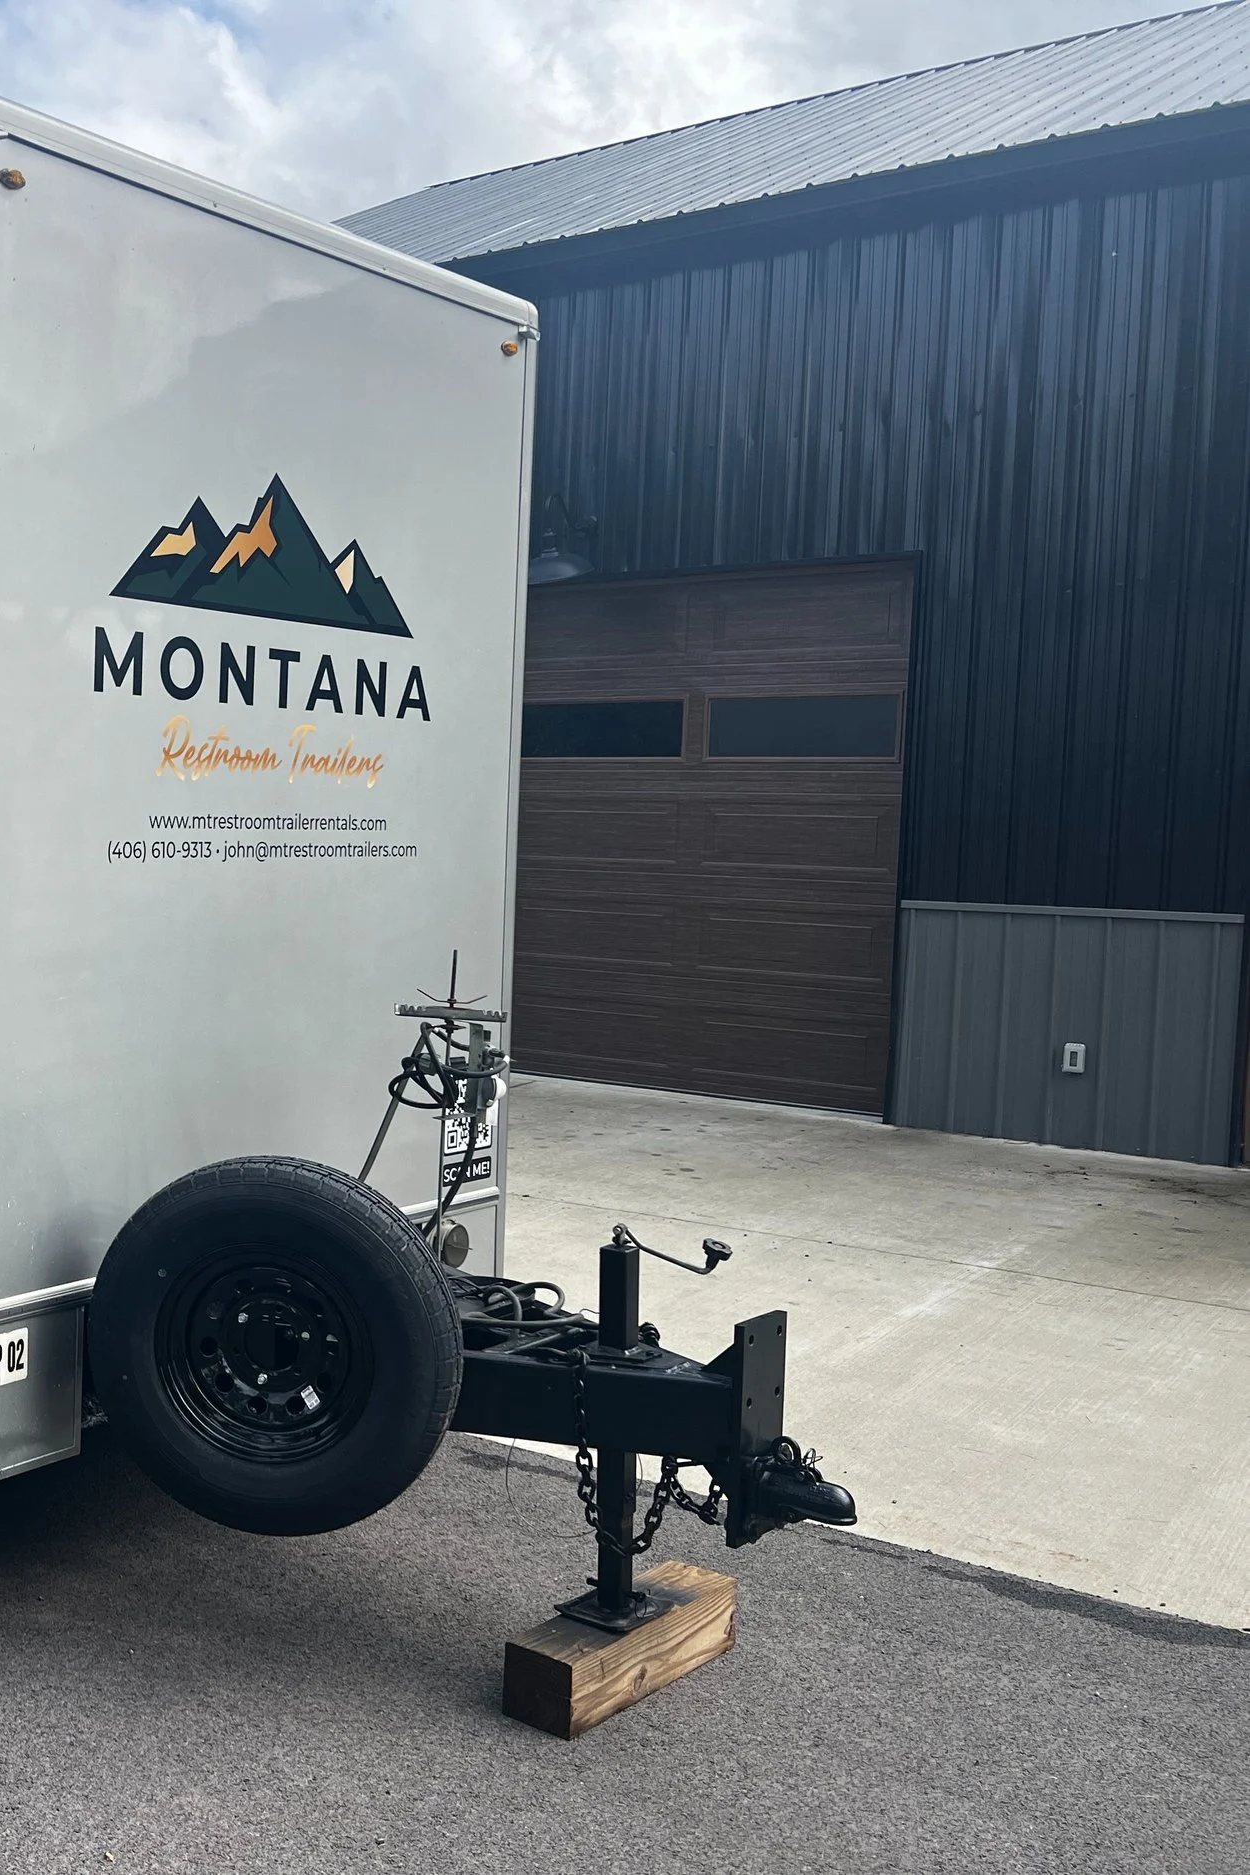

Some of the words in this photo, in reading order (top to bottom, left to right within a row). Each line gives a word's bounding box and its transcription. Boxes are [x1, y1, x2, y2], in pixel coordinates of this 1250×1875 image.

[93, 626, 431, 722] MONTANA
[155, 715, 282, 782] Restroom
[288, 724, 385, 790] Trailers
[148, 814, 387, 832] www.mtrestroomtrailerrentals.com
[107, 841, 147, 864] (406)
[151, 841, 212, 860] 610-9313
[222, 841, 418, 863] john@mtrestroomtrailers.com
[472, 1160, 490, 1177] ME!
[7, 1338, 25, 1373] 02
